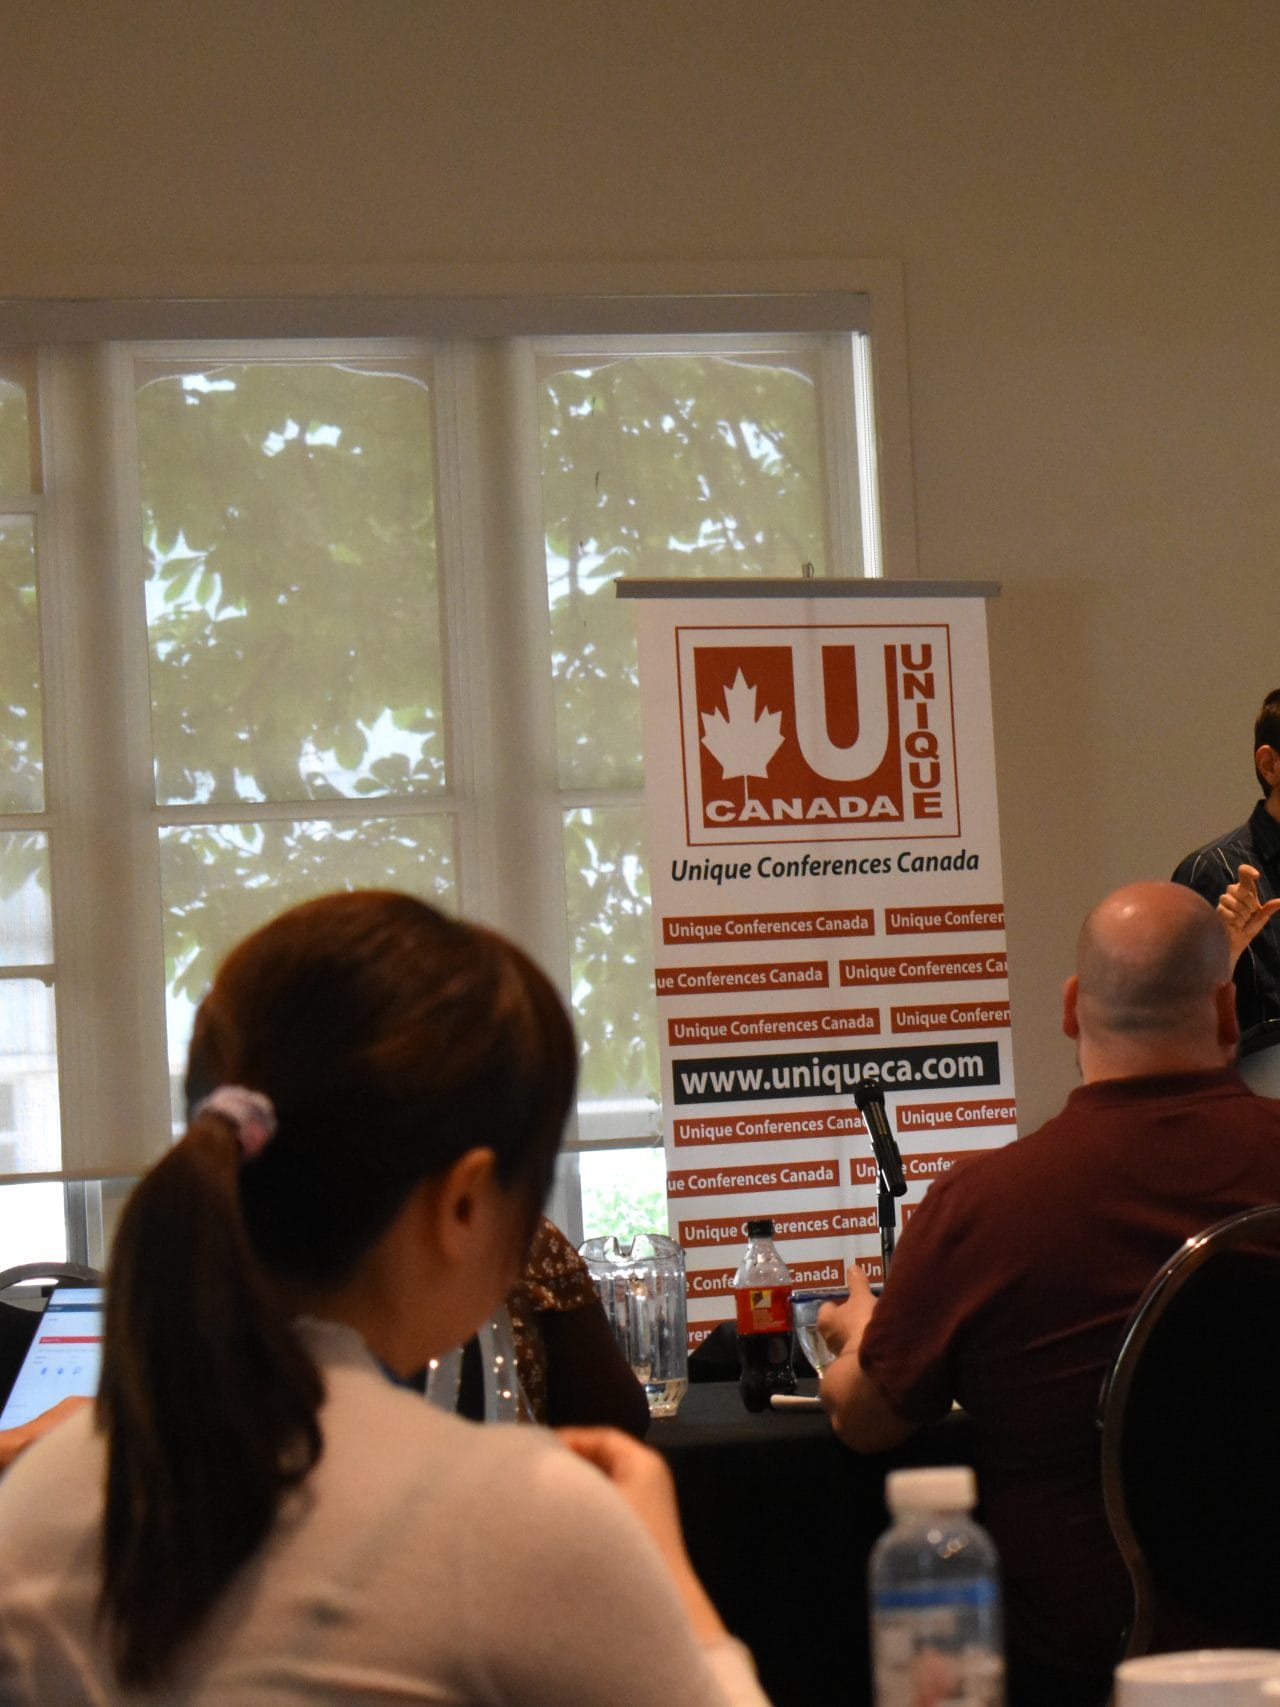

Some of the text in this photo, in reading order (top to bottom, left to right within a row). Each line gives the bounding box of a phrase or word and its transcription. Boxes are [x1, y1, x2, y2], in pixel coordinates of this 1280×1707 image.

[791, 645, 890, 781] U
[901, 644, 943, 819] UNIQUE
[706, 795, 899, 822] CANADA
[671, 849, 979, 885] Unique Conferences Canada
[668, 915, 869, 940] Unique Conferences Canada
[890, 912, 942, 930] Unique
[677, 969, 767, 988] Conferences
[770, 968, 823, 984] Canada
[845, 964, 896, 982] Unique
[899, 960, 982, 977] Conferences
[674, 1015, 874, 1041] Unique Conferences Canada
[896, 1011, 947, 1029] Unique
[680, 1054, 984, 1094] www.uniqueca.com
[679, 1115, 868, 1142] Unique Conferences Cana
[902, 1109, 953, 1127] Unique
[688, 1172, 777, 1190] Conferences
[780, 1168, 834, 1184] Canada
[685, 1225, 737, 1242] Unique
[832, 1212, 878, 1229] Canad
